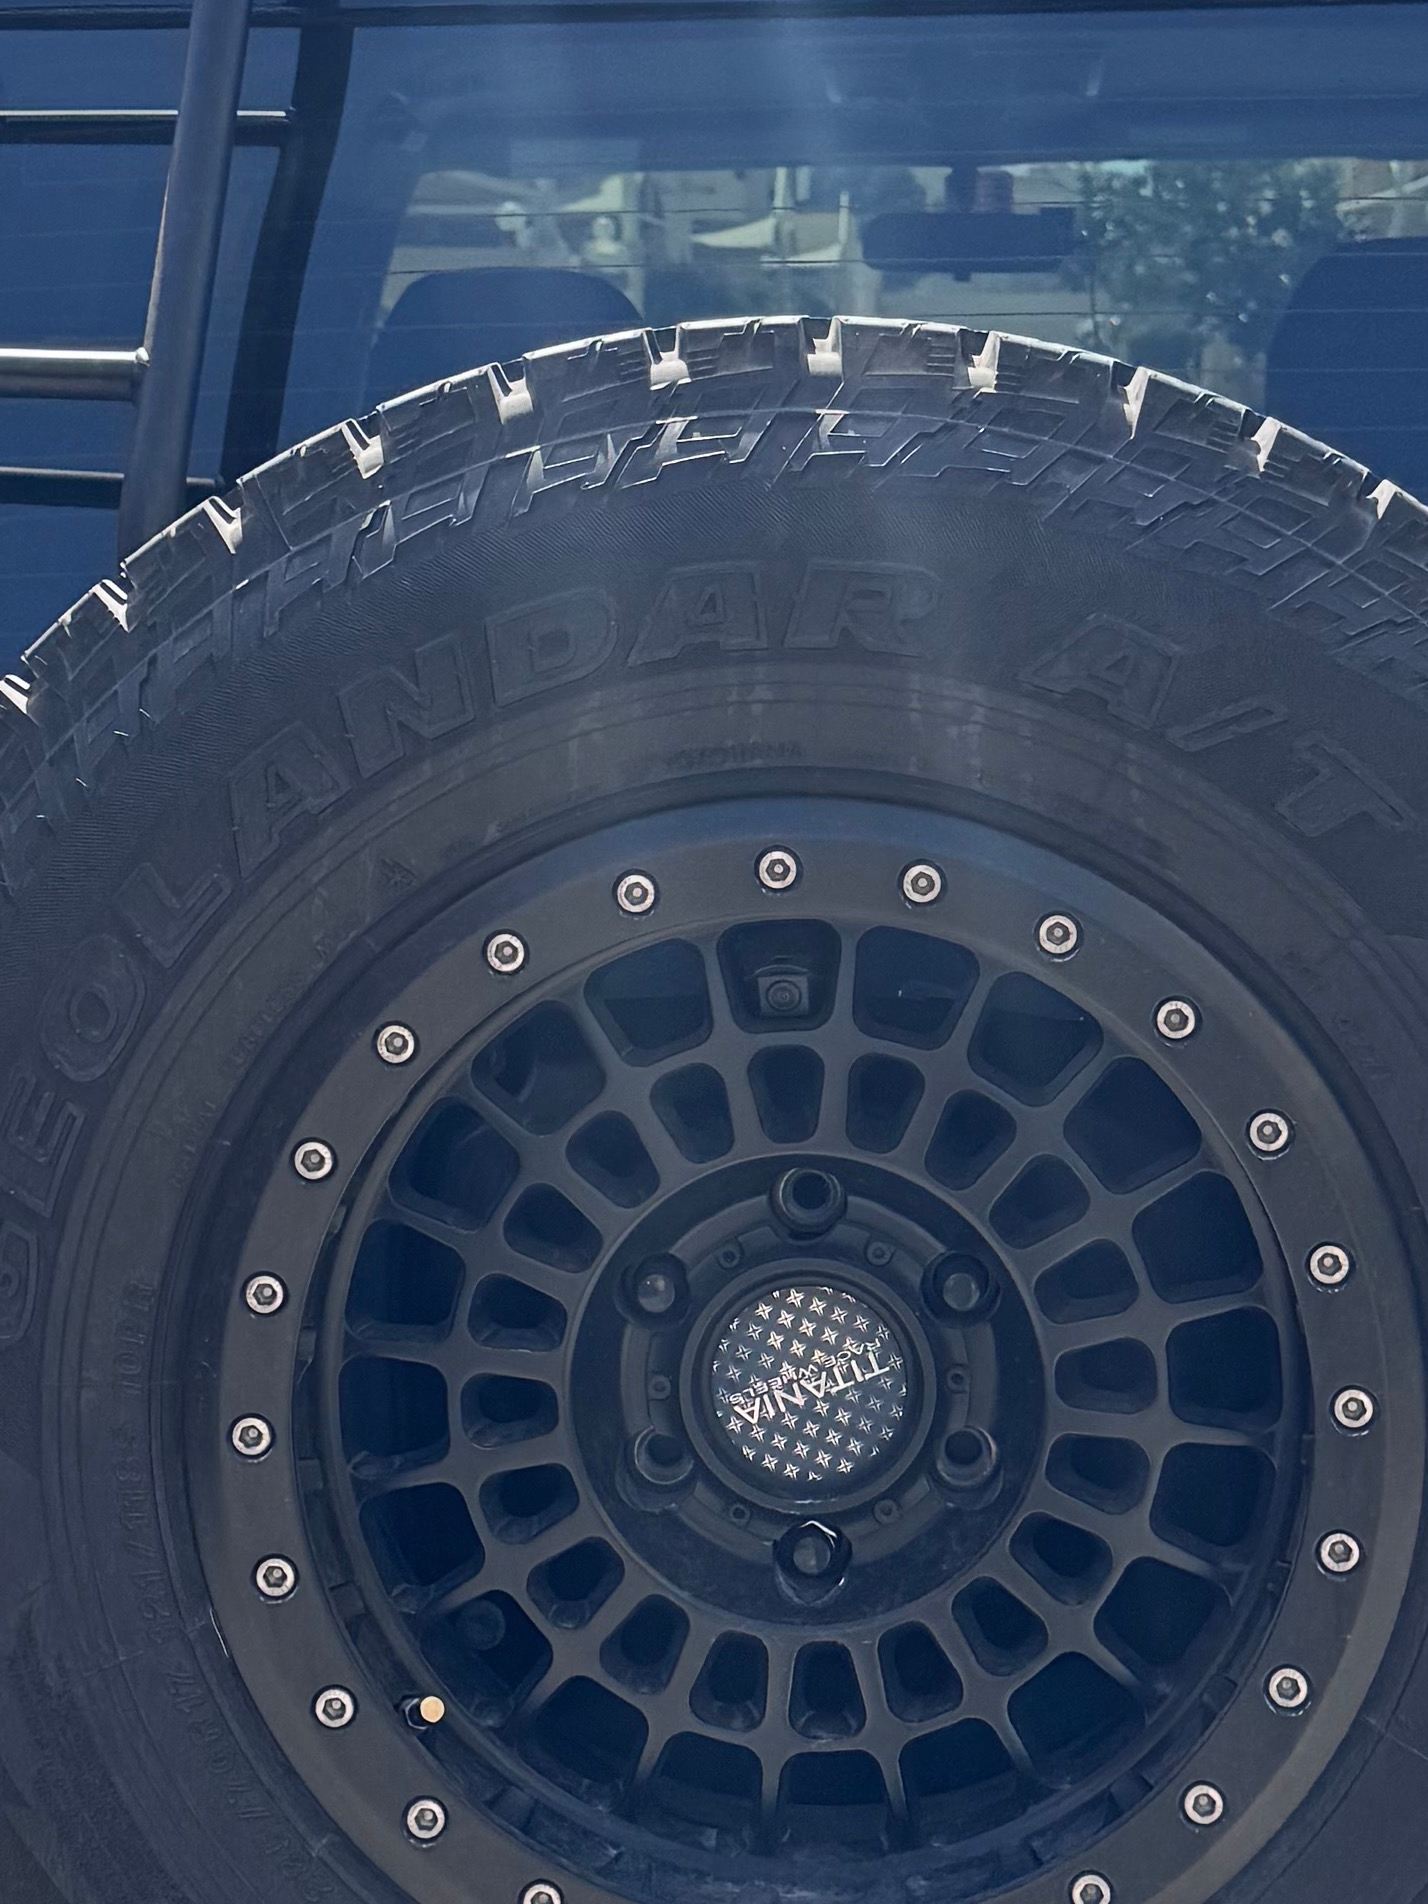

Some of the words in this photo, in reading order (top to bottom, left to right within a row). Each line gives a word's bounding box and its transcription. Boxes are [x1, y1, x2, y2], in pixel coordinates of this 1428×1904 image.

[1018, 611, 1418, 838] A/T
[824, 1338, 881, 1369] RACE
[728, 1364, 820, 1406] WHEELS
[733, 1350, 891, 1425] TITANIA
